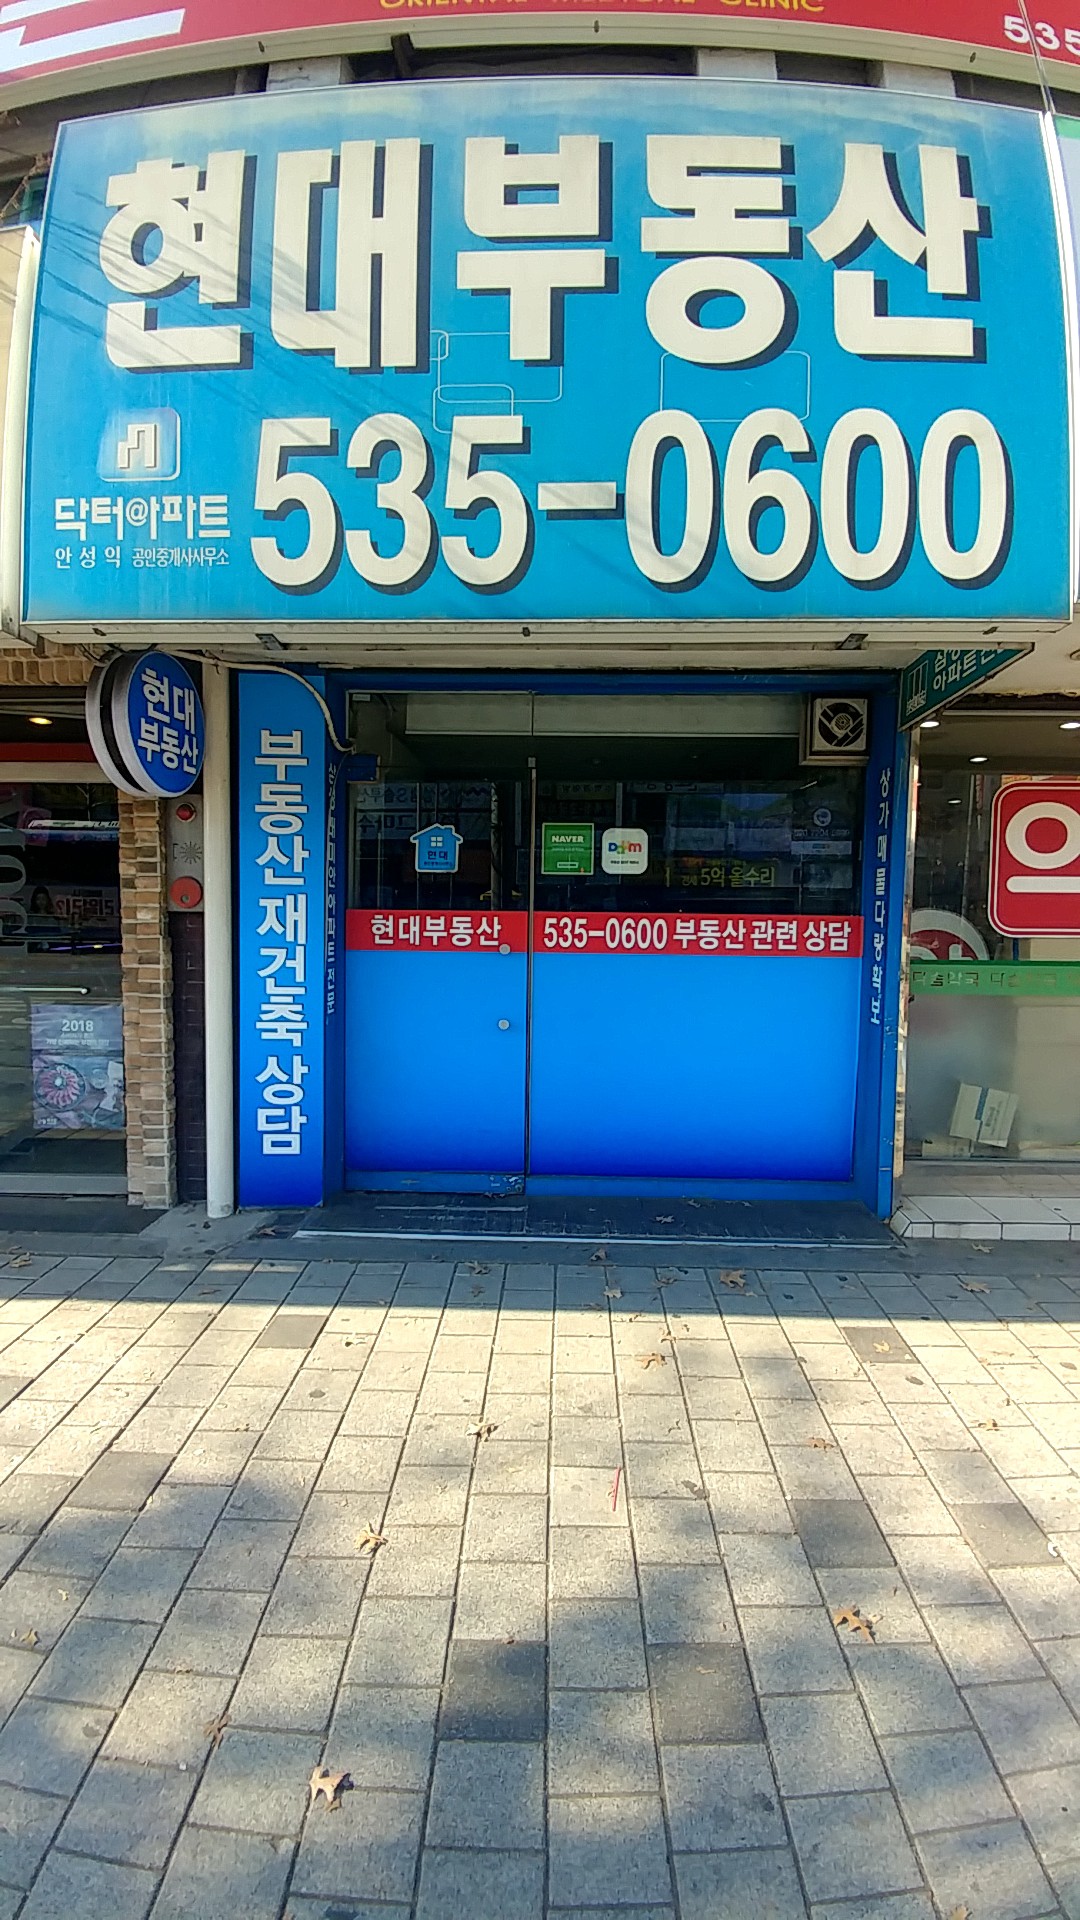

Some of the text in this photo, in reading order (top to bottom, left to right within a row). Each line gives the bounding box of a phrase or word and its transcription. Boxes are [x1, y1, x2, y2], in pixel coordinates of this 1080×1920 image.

[99, 134, 984, 371] 현대부동산
[251, 408, 1008, 588] 535-0600
[132, 547, 230, 568] 공인중개사사무소
[141, 667, 196, 735] 현대
[137, 717, 199, 775] 부동산
[551, 835, 584, 843] NAVER
[608, 840, 642, 854] Daum
[254, 729, 310, 1155] 부동산 재건축 상담
[370, 914, 503, 947] 현대부동산
[543, 917, 852, 952] 535-0600 부동산 관련 상담
[61, 1019, 94, 1032] 2018
